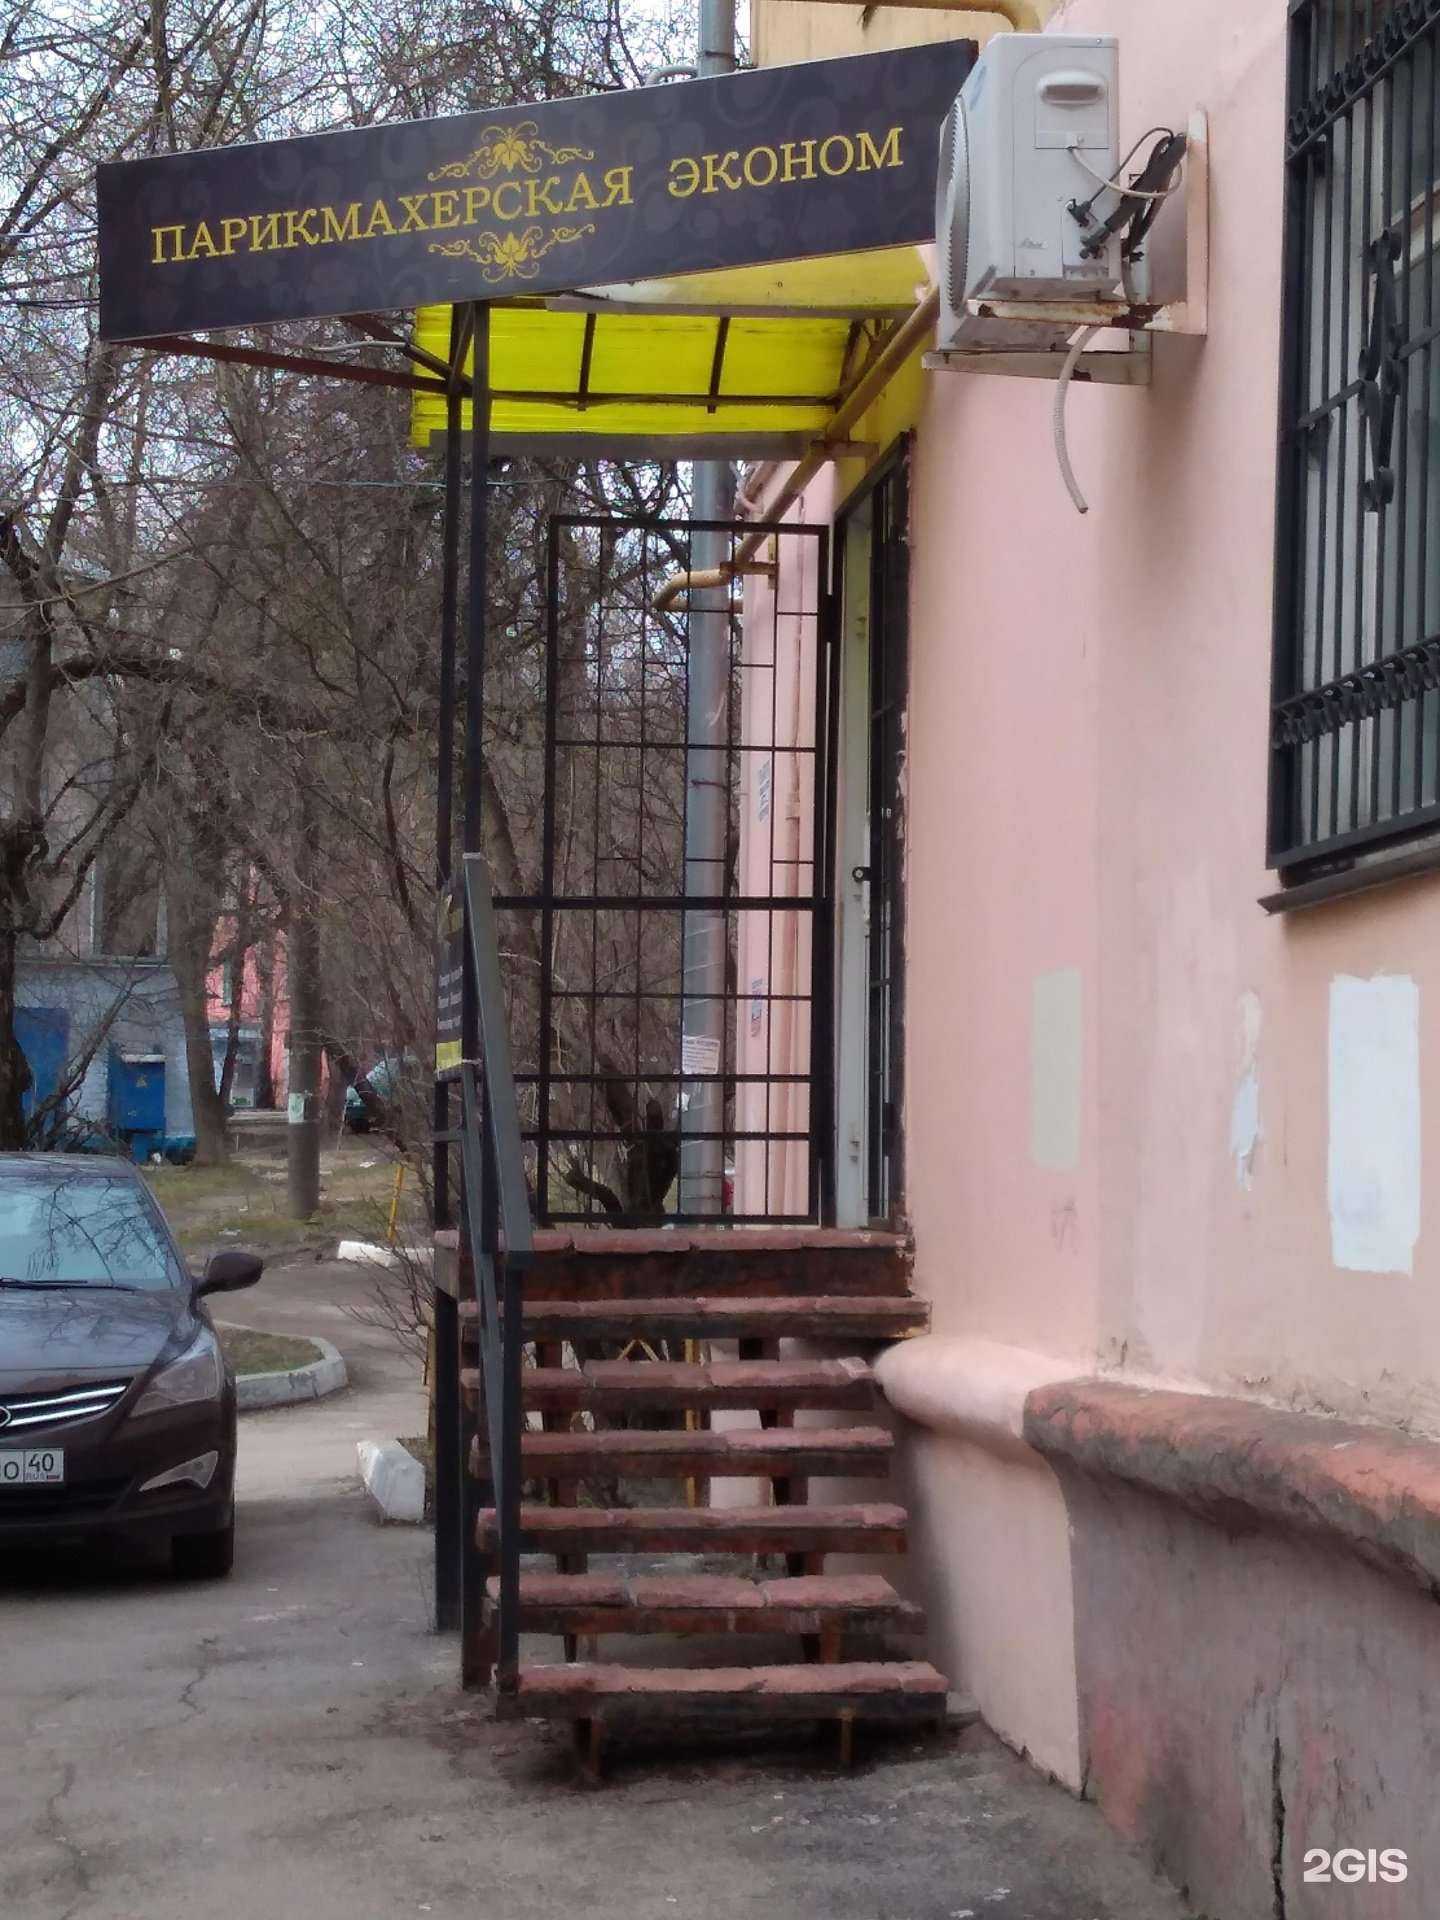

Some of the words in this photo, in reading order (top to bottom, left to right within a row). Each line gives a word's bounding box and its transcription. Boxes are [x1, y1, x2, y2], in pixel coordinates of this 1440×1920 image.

[151, 165, 634, 264] ПАРИКМАХЕРСКАЯ
[668, 127, 904, 197] ЭКОНОМ
[28, 1453, 54, 1472] 40
